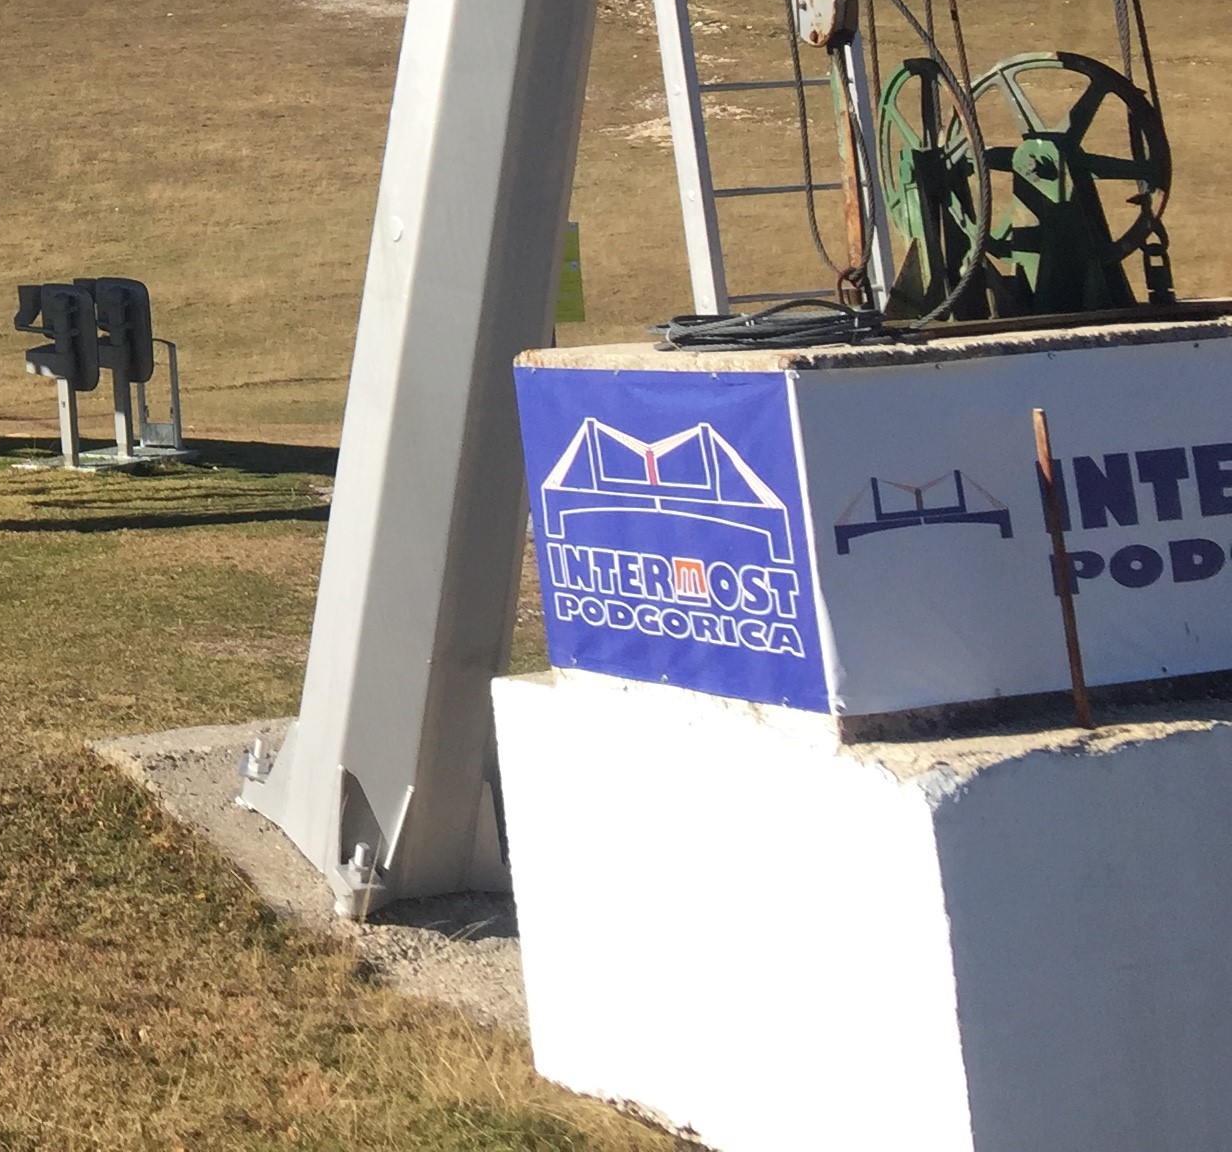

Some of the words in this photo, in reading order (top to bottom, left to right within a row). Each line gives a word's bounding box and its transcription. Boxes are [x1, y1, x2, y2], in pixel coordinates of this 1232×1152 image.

[1035, 443, 1232, 533] INTE
[1049, 538, 1232, 596] POD
[555, 592, 805, 658] PODGORICA
